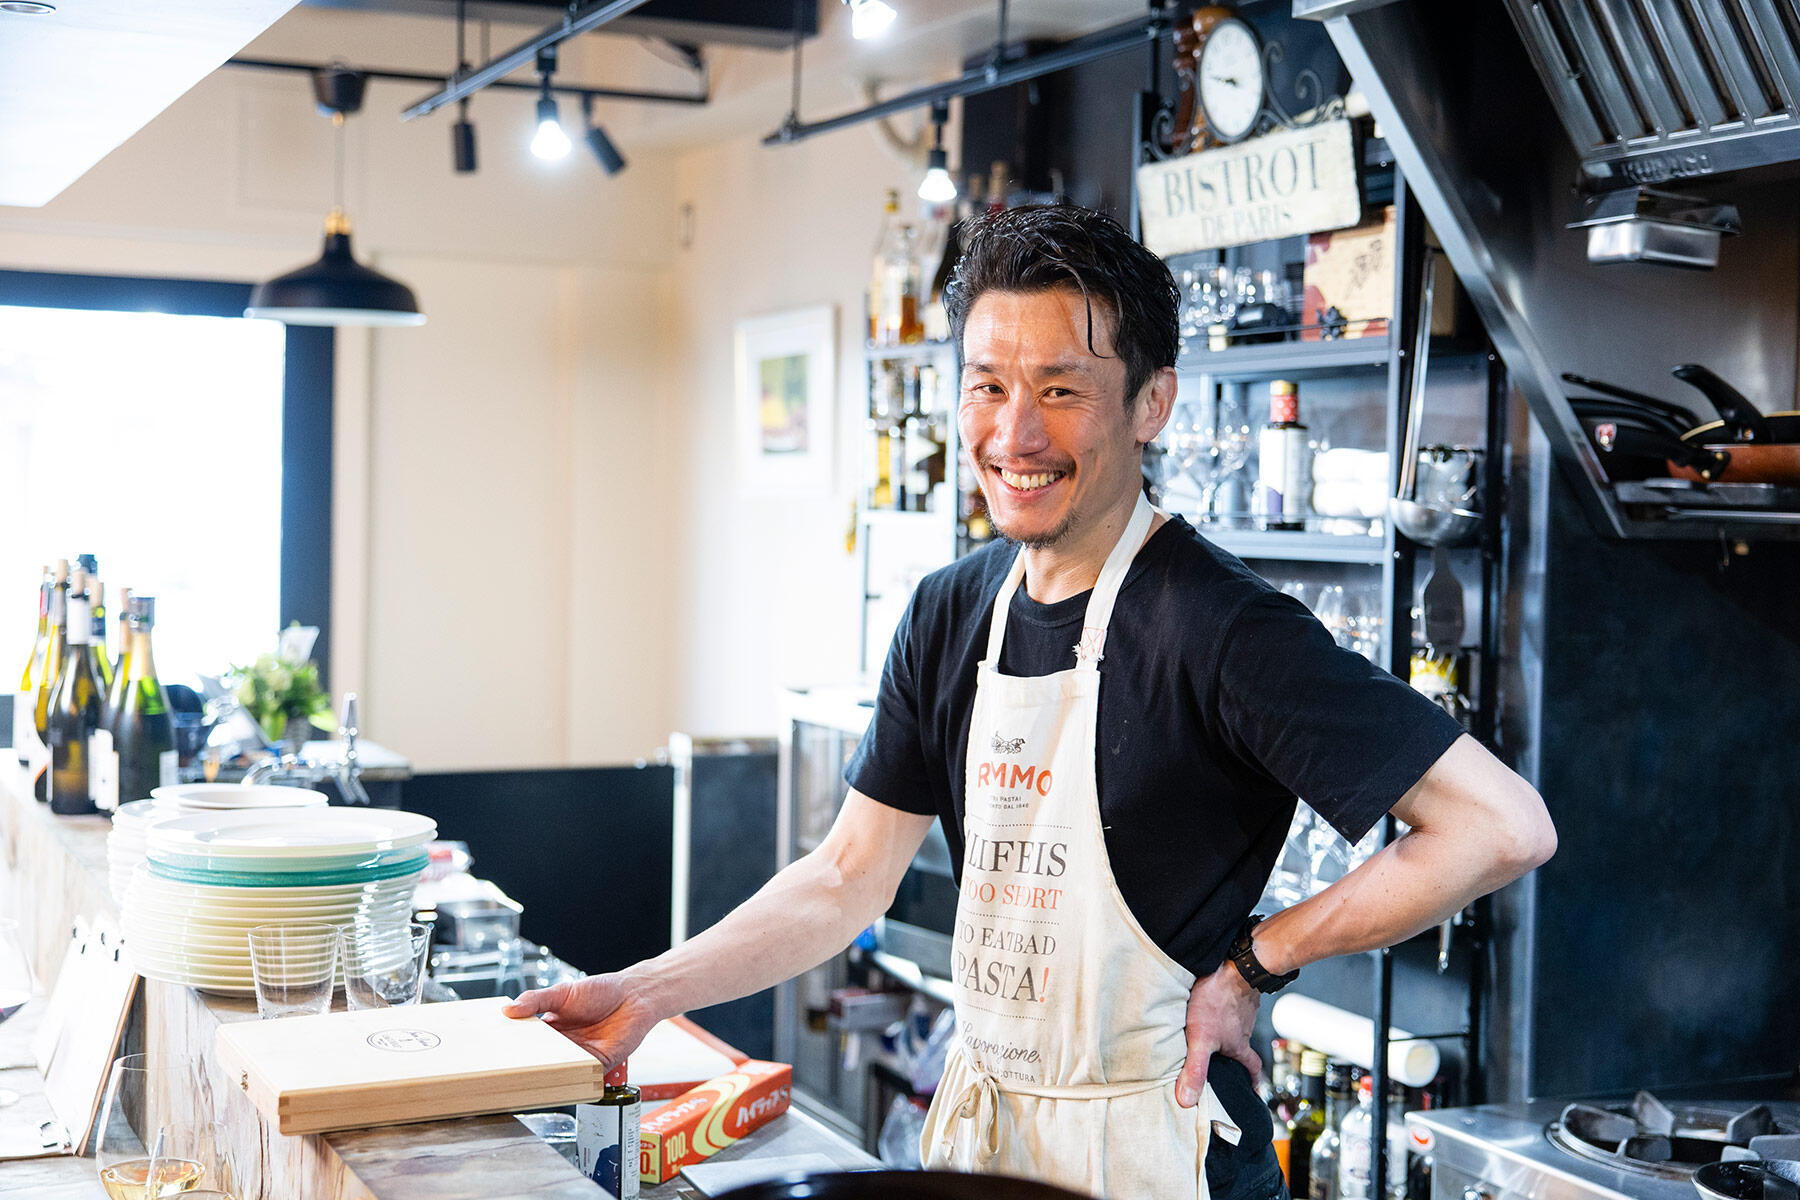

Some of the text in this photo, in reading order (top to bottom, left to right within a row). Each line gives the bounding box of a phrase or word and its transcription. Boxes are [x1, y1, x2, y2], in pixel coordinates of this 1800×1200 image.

[1163, 138, 1326, 218] BISTROT
[957, 951, 1050, 1003] PASTA!
[1000, 1070, 1036, 1083] OTTURA
